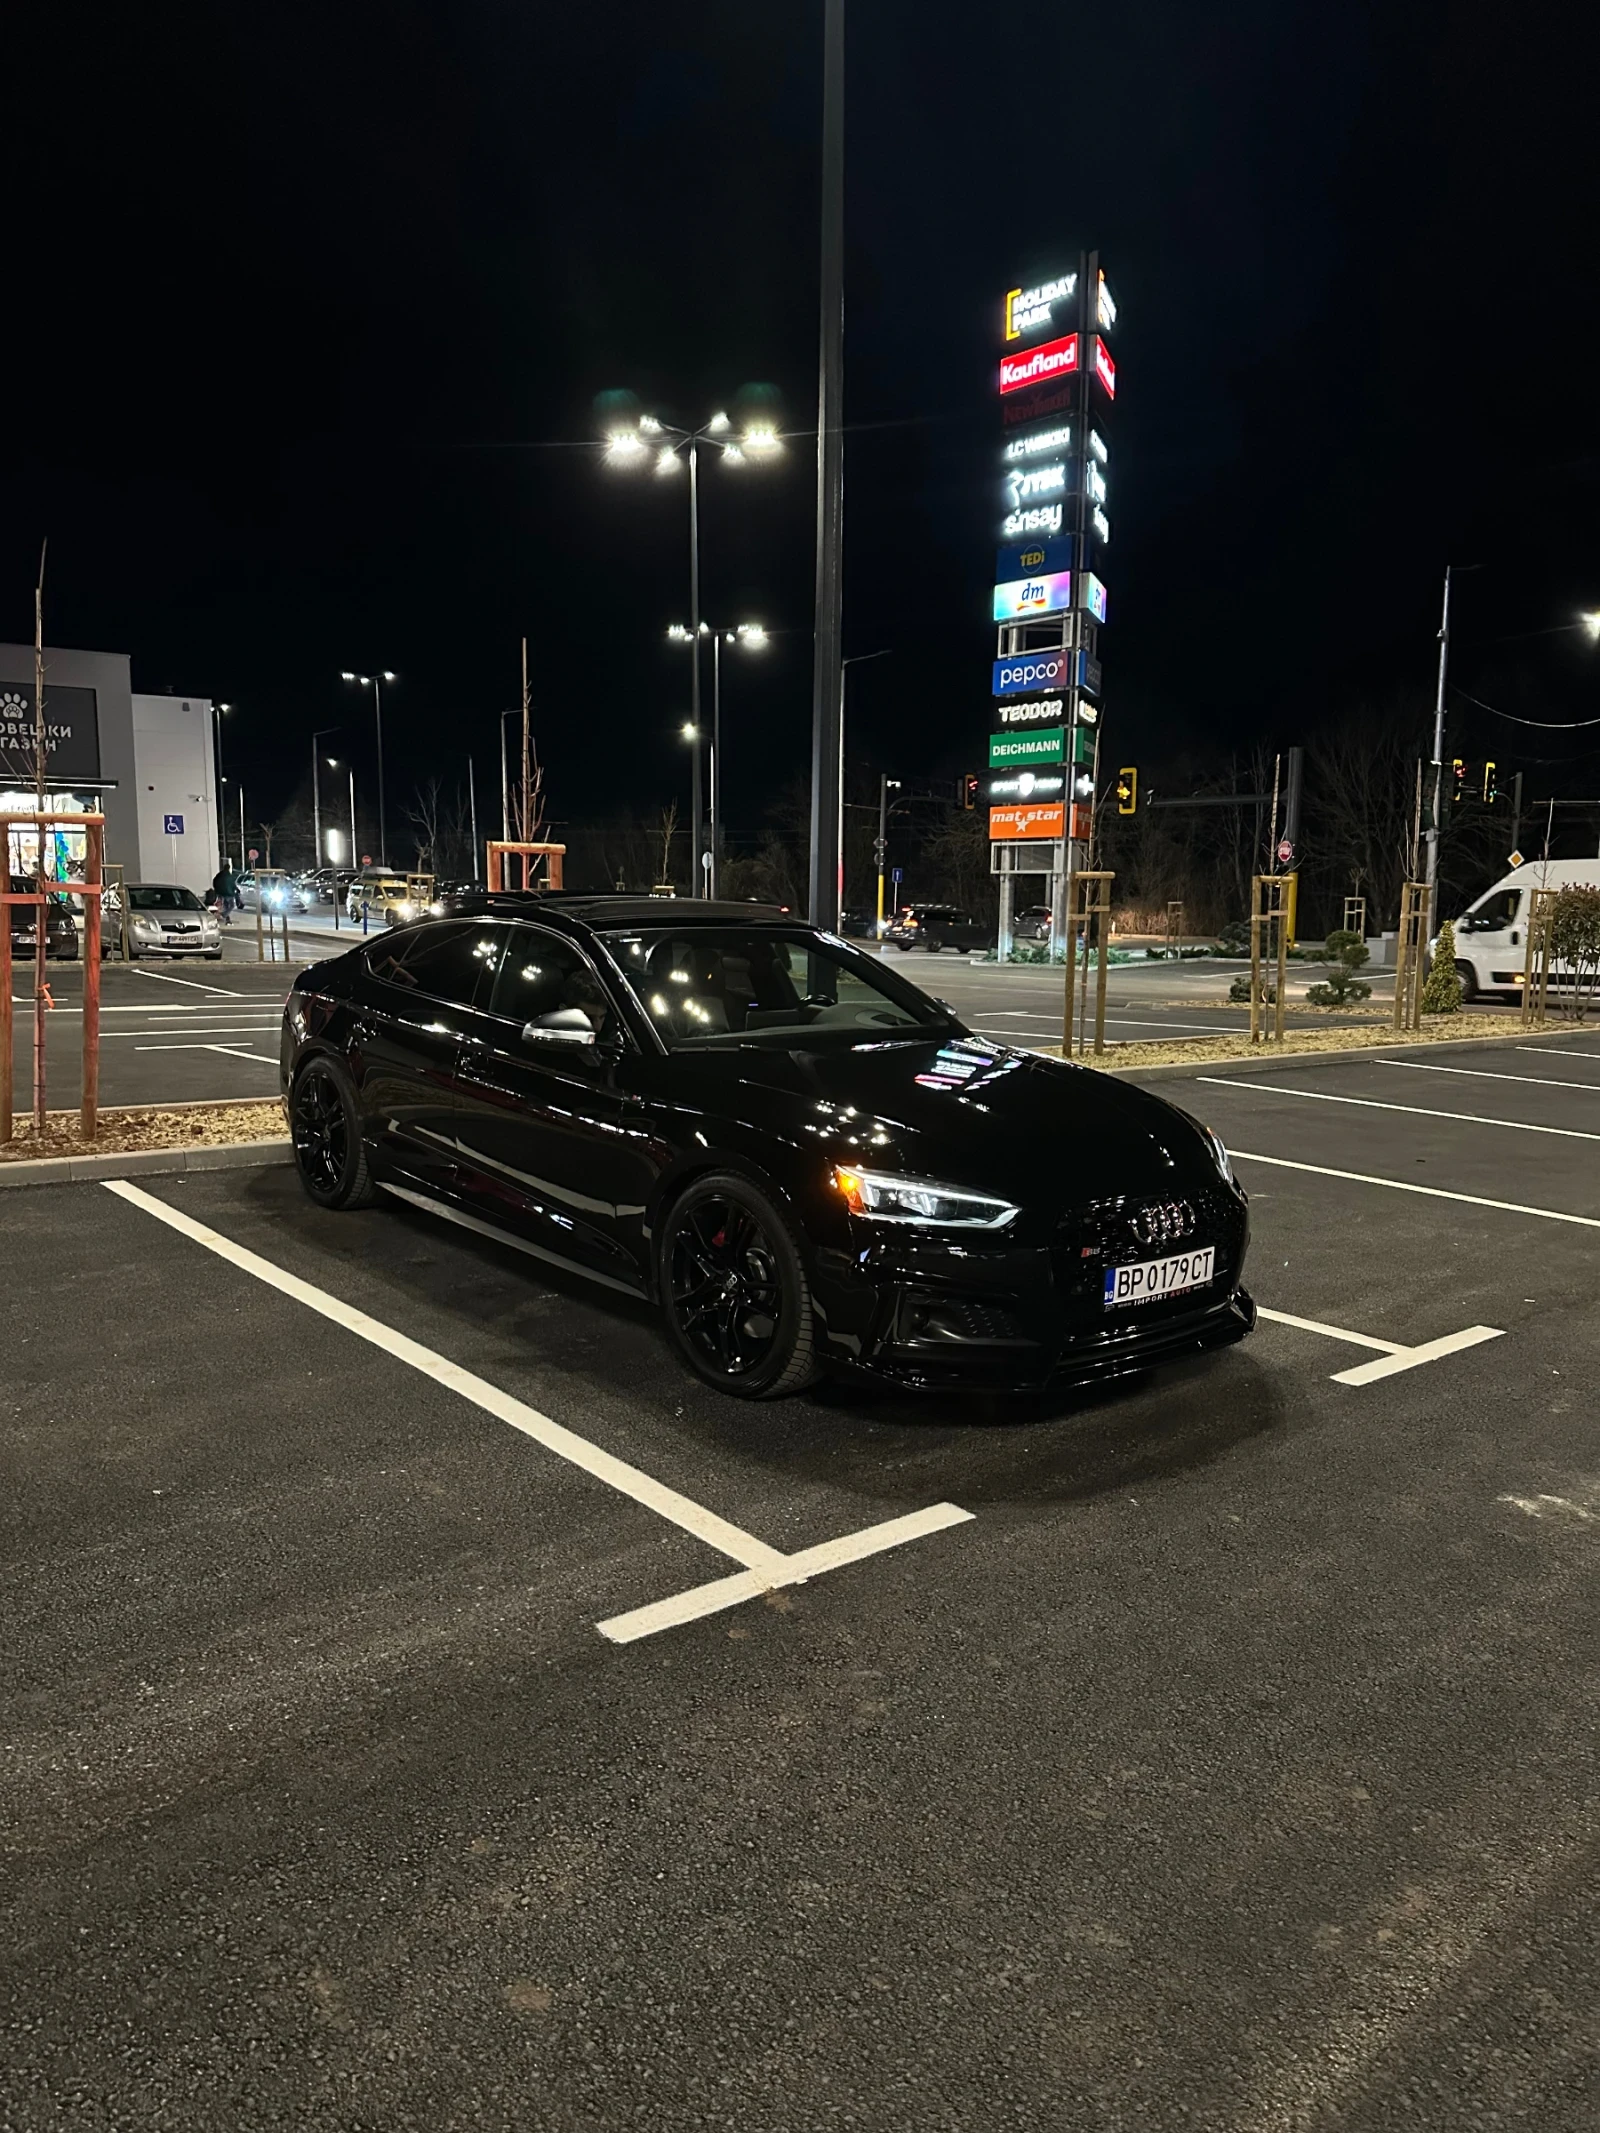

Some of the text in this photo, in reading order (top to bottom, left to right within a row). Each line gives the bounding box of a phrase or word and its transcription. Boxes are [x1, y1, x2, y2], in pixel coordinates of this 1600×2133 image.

[1012, 273, 1077, 316] HOLIDAY
[1002, 342, 1075, 385] Kaufland
[1004, 503, 1063, 534] sinsay
[1022, 582, 1045, 601] dm
[998, 700, 1063, 722] TEODOR
[992, 739, 1060, 757] DEICHMANN
[991, 809, 1062, 823] mat star
[1104, 1290, 1114, 1300] BG
[1133, 1292, 1168, 1307] IMPORT
[1169, 1286, 1191, 1298] AUTO
